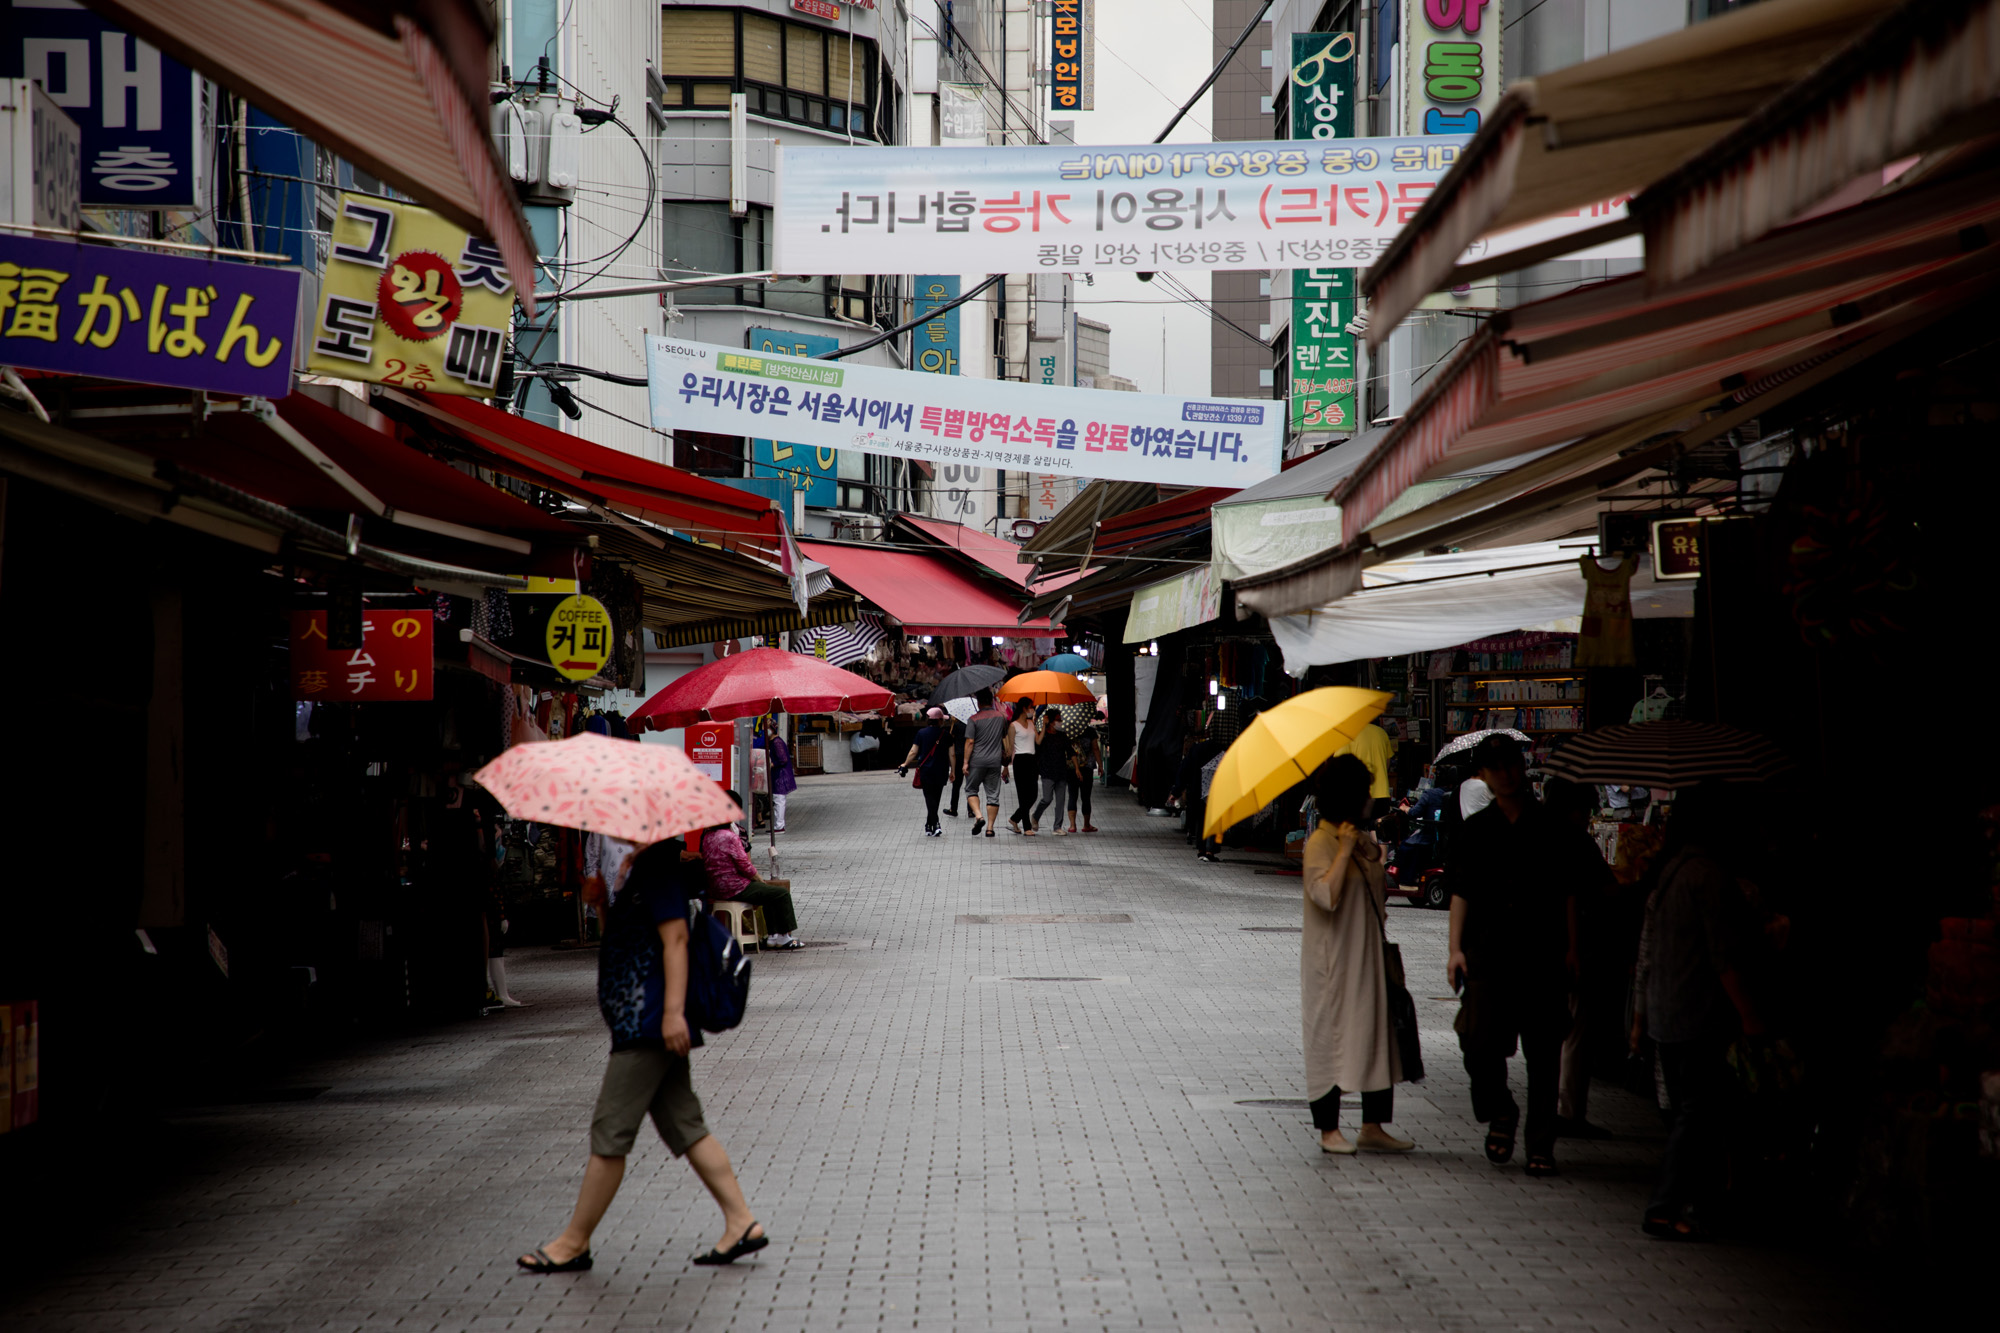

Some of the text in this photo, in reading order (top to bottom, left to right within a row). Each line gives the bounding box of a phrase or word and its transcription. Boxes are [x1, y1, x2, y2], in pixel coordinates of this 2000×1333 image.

[91, 145, 178, 191] 층
[1296, 345, 1350, 370] 렌즈
[1294, 378, 1353, 394] 756-4887
[679, 372, 1248, 463] 우리시장은 서울시에서 특별방역소독을 완료하였습니다.
[1227, 414, 1242, 423] 1339
[1247, 415, 1260, 424] 120
[1303, 400, 1345, 425] 5층
[1033, 455, 1074, 470] 살립니다.
[558, 610, 602, 623] COFFEE
[552, 624, 607, 657] 커피
[391, 617, 421, 693] のり
